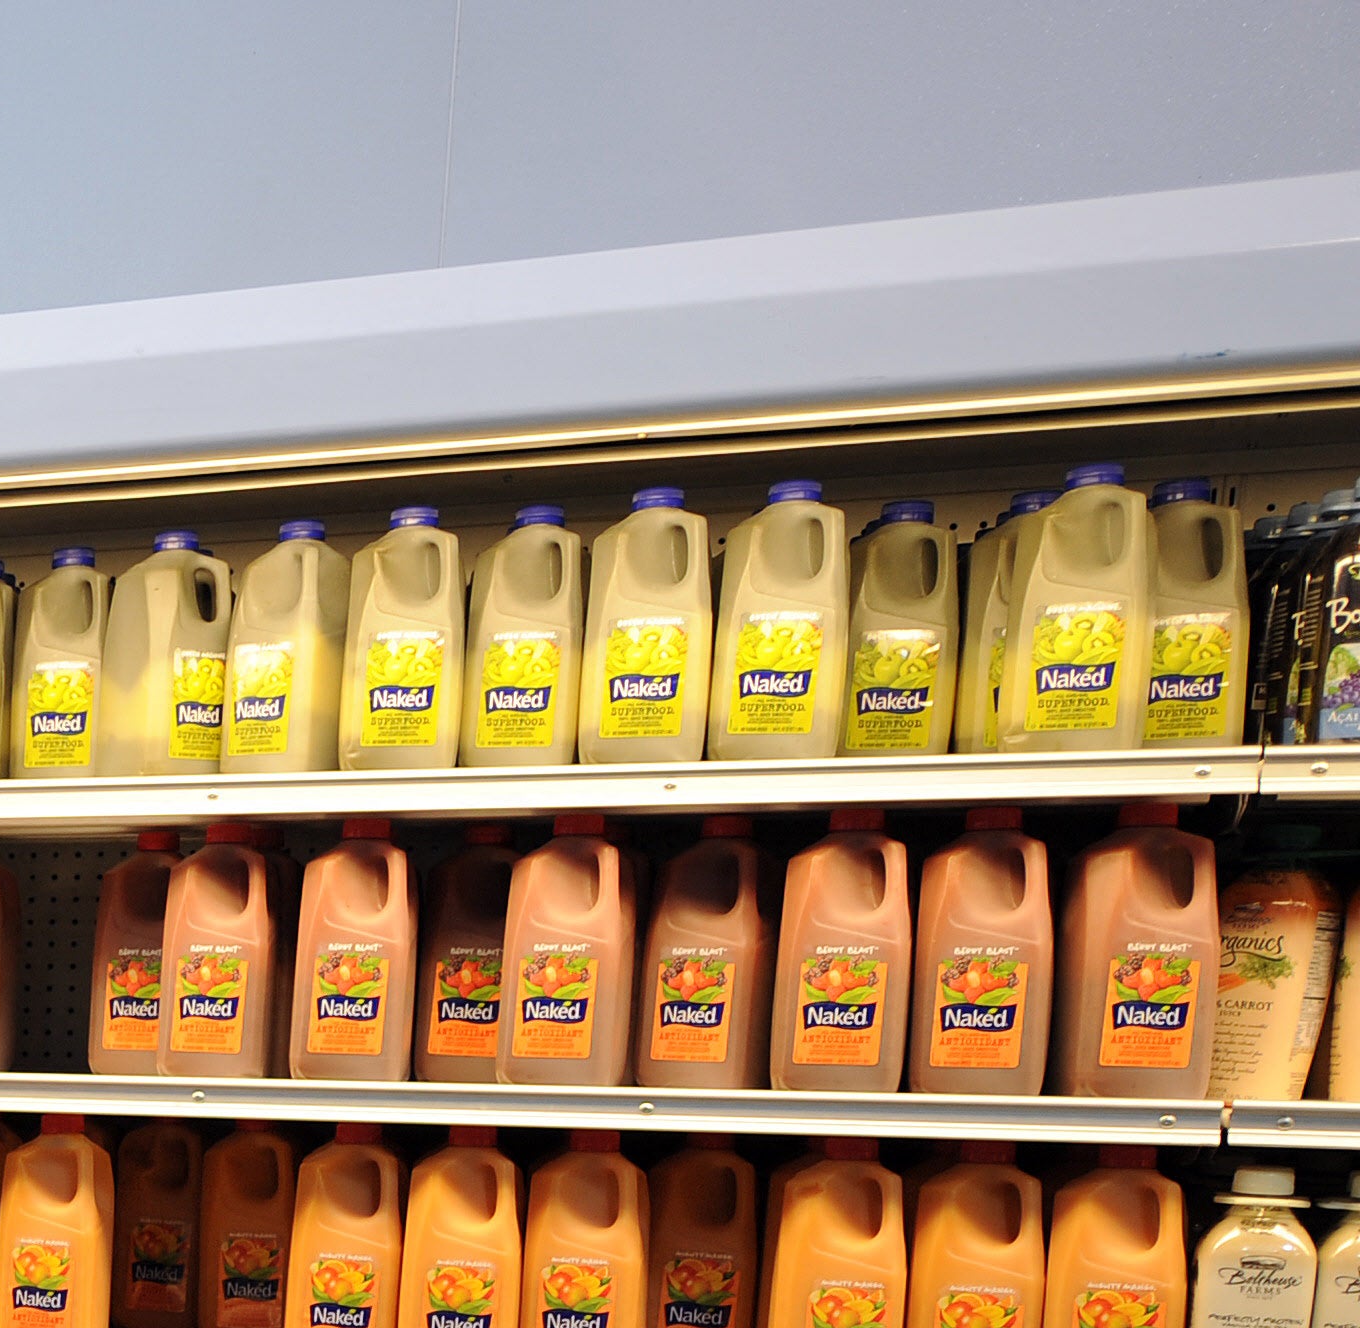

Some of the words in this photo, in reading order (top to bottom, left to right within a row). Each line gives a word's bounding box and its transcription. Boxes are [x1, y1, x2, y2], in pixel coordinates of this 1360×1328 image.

[743, 674, 804, 693] Naked
[1041, 669, 1106, 688] Naked
[613, 678, 672, 698] Naked
[1151, 678, 1215, 699] Naked
[373, 690, 428, 708] Naked
[489, 690, 543, 708] Naked
[861, 692, 920, 710] Naked
[1038, 697, 1109, 708] SUPERFOOD
[179, 705, 220, 723] Naked
[236, 701, 279, 717] Naked
[1148, 708, 1218, 718] SUPERFOOD
[34, 716, 81, 733] Naked
[1221, 932, 1284, 957] rganics
[112, 1001, 158, 1017] Naked
[183, 1000, 233, 1017] Naked
[320, 1000, 373, 1017] Naked
[442, 1002, 494, 1020] Naked
[526, 1001, 581, 1019] Naked
[664, 1005, 717, 1025] Naked
[1225, 1001, 1273, 1011] CARROT
[807, 1007, 868, 1026] Naked
[944, 1009, 1008, 1028] Naked
[1117, 1006, 1180, 1026] Naked
[135, 1267, 178, 1281] Naked
[1219, 1267, 1302, 1289] Bolthouse
[16, 1290, 61, 1308] Naked
[227, 1283, 271, 1297] Naked
[1240, 1286, 1281, 1294] FARMS
[314, 1307, 364, 1326] Naked
[669, 1307, 722, 1325] Naked
